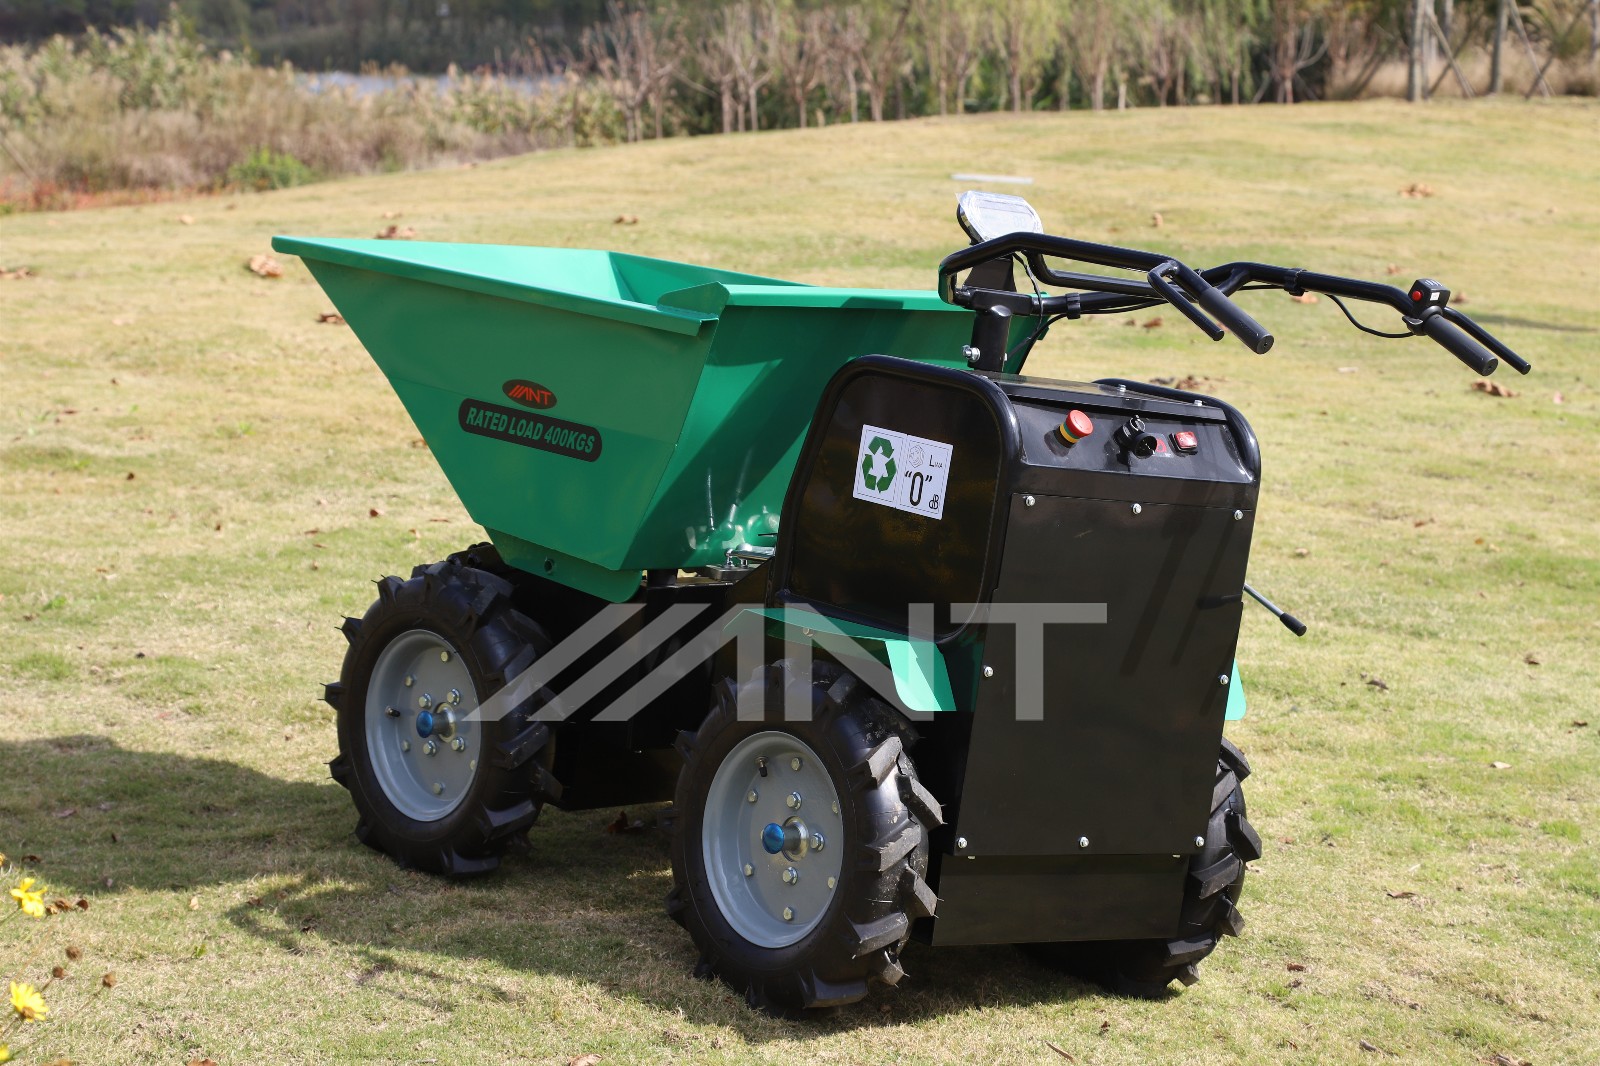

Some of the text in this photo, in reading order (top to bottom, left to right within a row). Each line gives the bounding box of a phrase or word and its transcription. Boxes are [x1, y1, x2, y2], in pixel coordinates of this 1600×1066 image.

[466, 407, 595, 453] RATED LOAD 400KGS
[929, 494, 939, 510] dB
